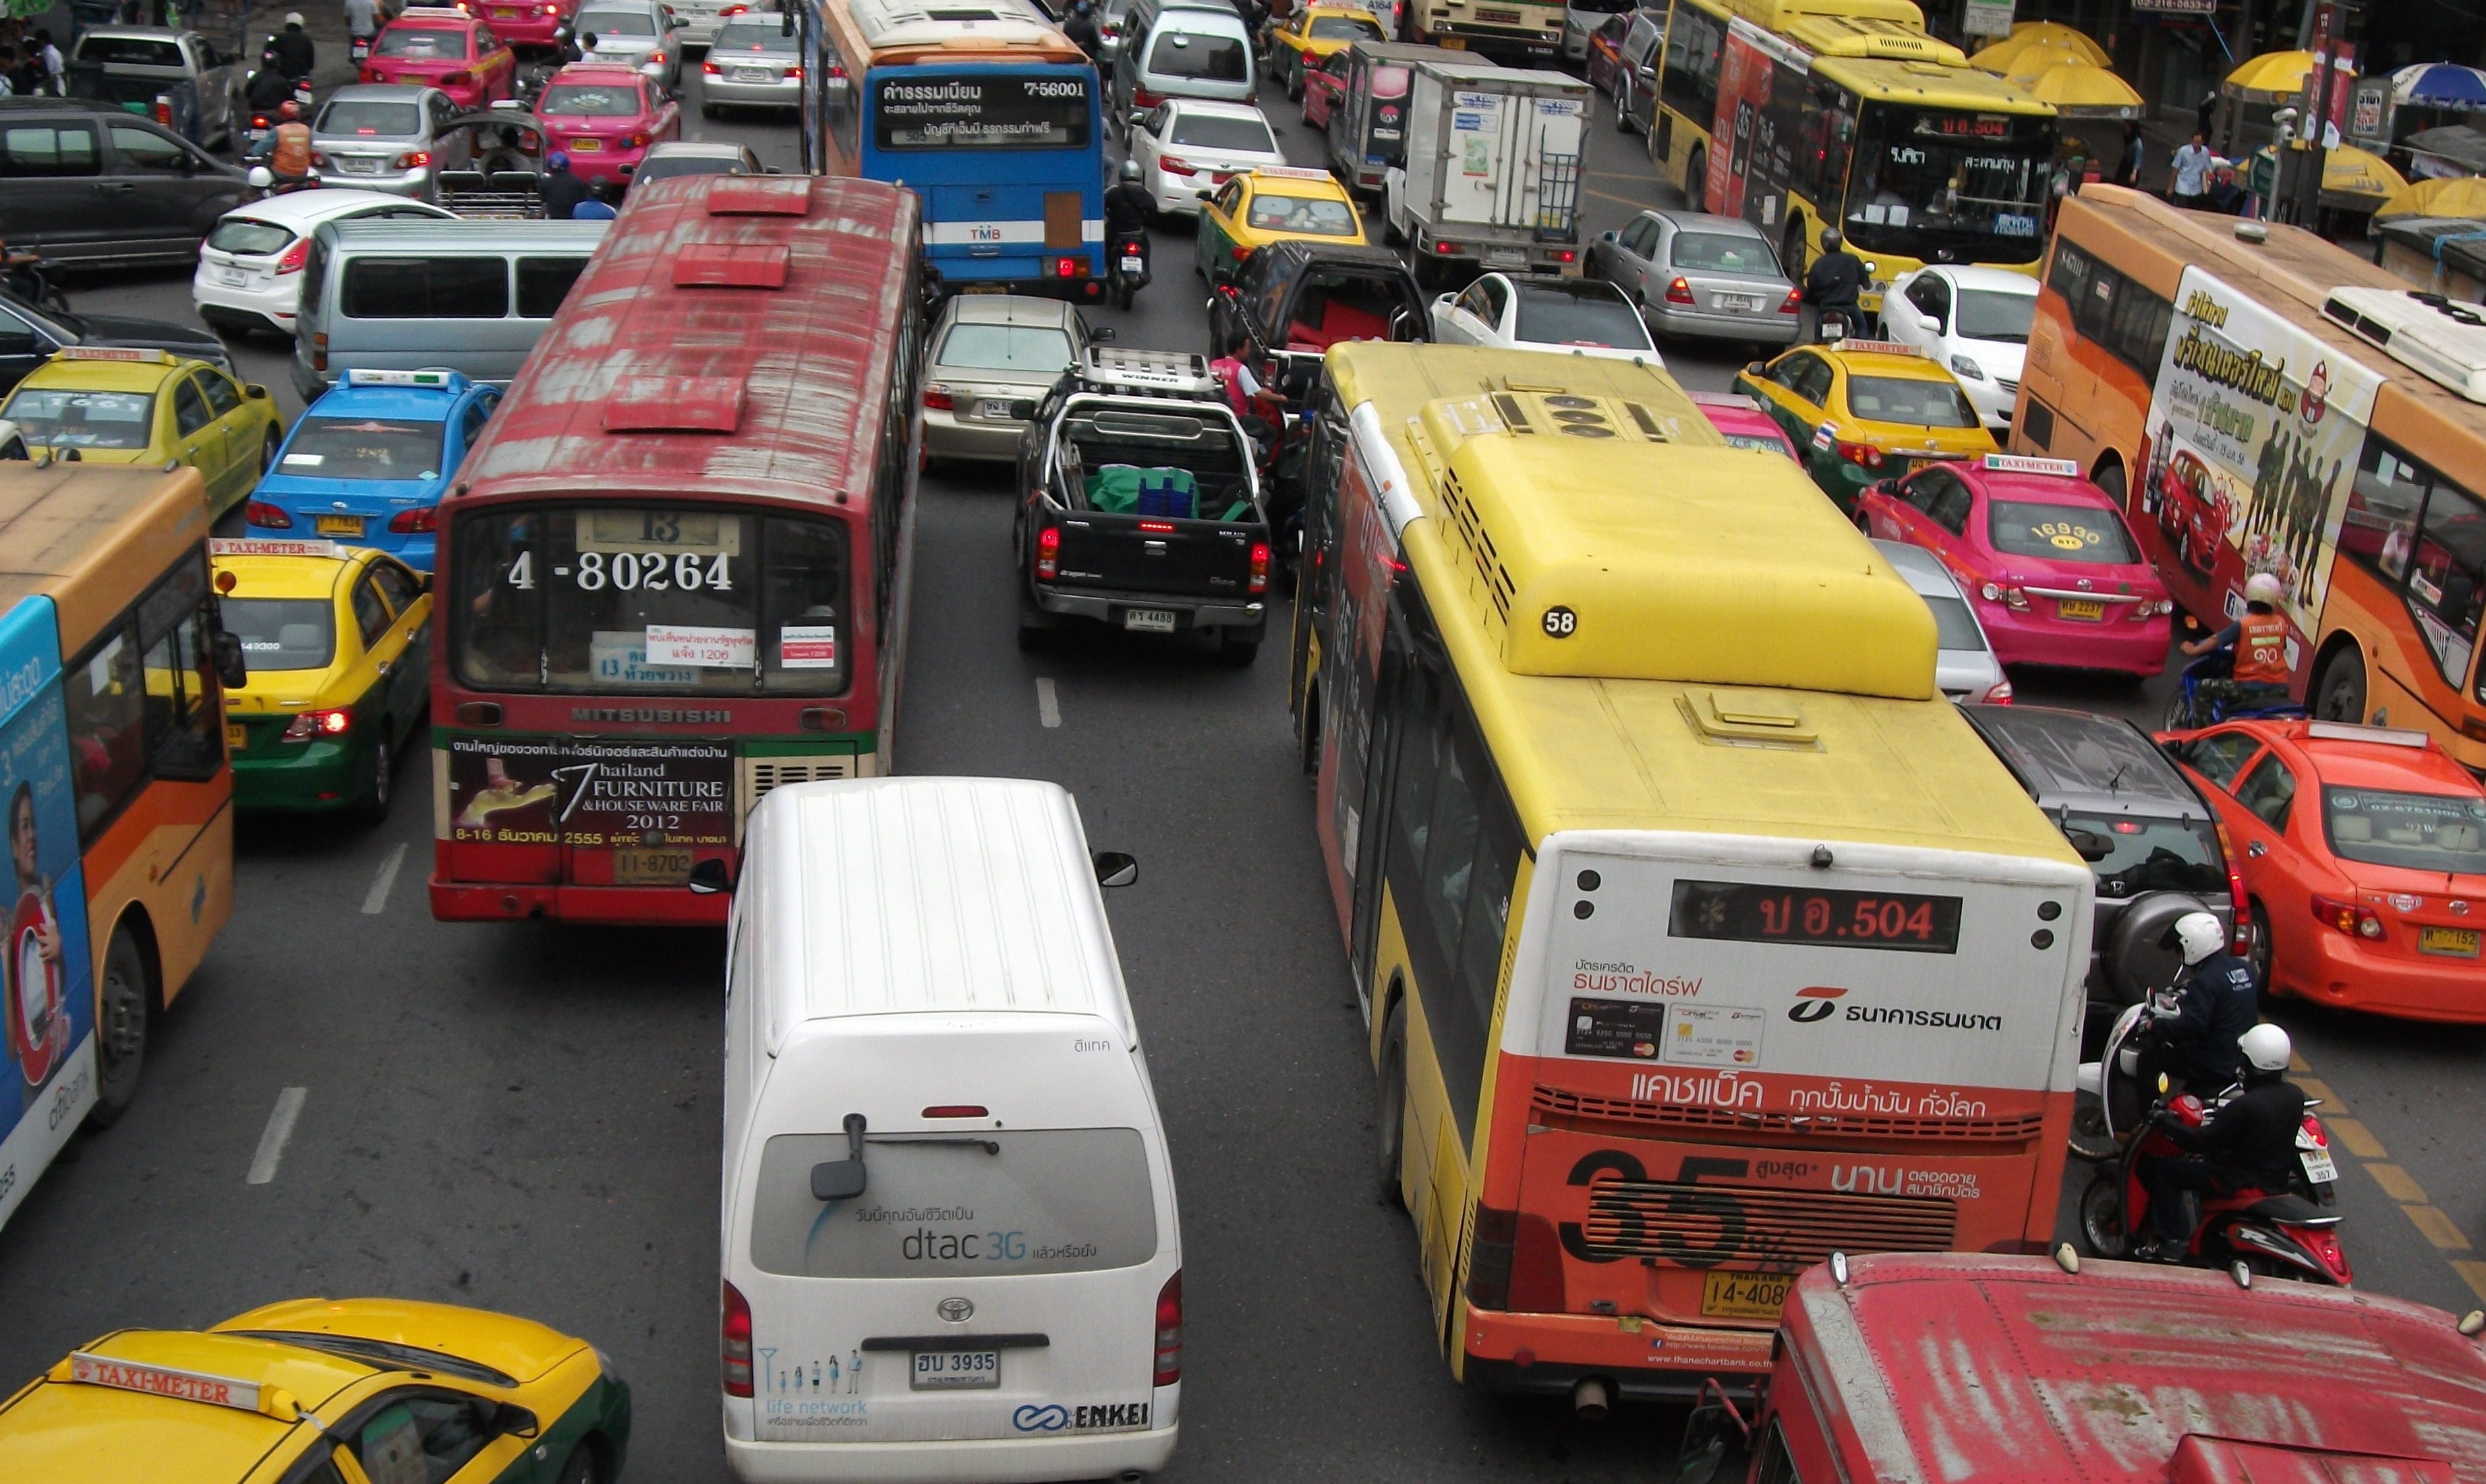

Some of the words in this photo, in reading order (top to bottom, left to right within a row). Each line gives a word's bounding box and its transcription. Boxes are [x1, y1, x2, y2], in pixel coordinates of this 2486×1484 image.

[884, 82, 982, 99] ค่าธรรมเนียม
[1024, 82, 1085, 96] 7-56001
[969, 225, 1001, 240] TMB
[1122, 373, 1179, 384] WINNER
[2031, 522, 2101, 544] 16930
[228, 541, 306, 555] TAXI-METER
[1545, 612, 1574, 634] 58
[672, 647, 695, 659] แจ้ง
[700, 649, 729, 661] 1206
[600, 659, 620, 676] 13
[623, 665, 692, 683] ห้วยขวาง
[571, 709, 731, 723] MITSUBISHI
[593, 781, 724, 798] FURNITURE
[691, 800, 724, 812] FAIR
[626, 814, 680, 830] 2012
[456, 828, 492, 841] 8-16
[498, 827, 558, 843] ธันวาคม
[565, 833, 603, 845] 2555
[697, 835, 727, 844] บางนา
[1760, 894, 1792, 935] ป
[1575, 958, 1635, 974] บัตรเครดิต
[1573, 970, 1703, 998] ธนชาตไดร์ฟ
[1845, 1005, 2002, 1032] ธนาคารธนชาต
[1074, 1038, 1111, 1053] ดีแทค
[1631, 1070, 1764, 1108] แคชแบ็ค
[1790, 1081, 1910, 1115] ทุกปั๊มน้ำมัน
[1918, 1089, 1986, 1118] ทั่วโลก
[1830, 1164, 1904, 1195] นาน
[1907, 1170, 1977, 1188] ตลอดอายุ
[1906, 1183, 1980, 1199] สมาชิกบัตร
[855, 1206, 974, 1224] วันนี้คุณอัพชีวิตเป็น
[902, 1227, 979, 1261] dtac
[985, 1230, 1027, 1261] 3G
[1032, 1244, 1097, 1259] แล้วหรือยัง
[1729, 1272, 1783, 1282] THAILAND
[1712, 1280, 1790, 1306] 14-408
[918, 1353, 944, 1373] ฮบ
[951, 1354, 995, 1371] 3935
[1647, 1355, 1772, 1368] www.thanachartbank.co.th
[95, 1363, 230, 1404] TAXI-METER
[766, 1399, 792, 1414] life
[799, 1400, 868, 1415] network
[1075, 1402, 1149, 1429] ENKEI
